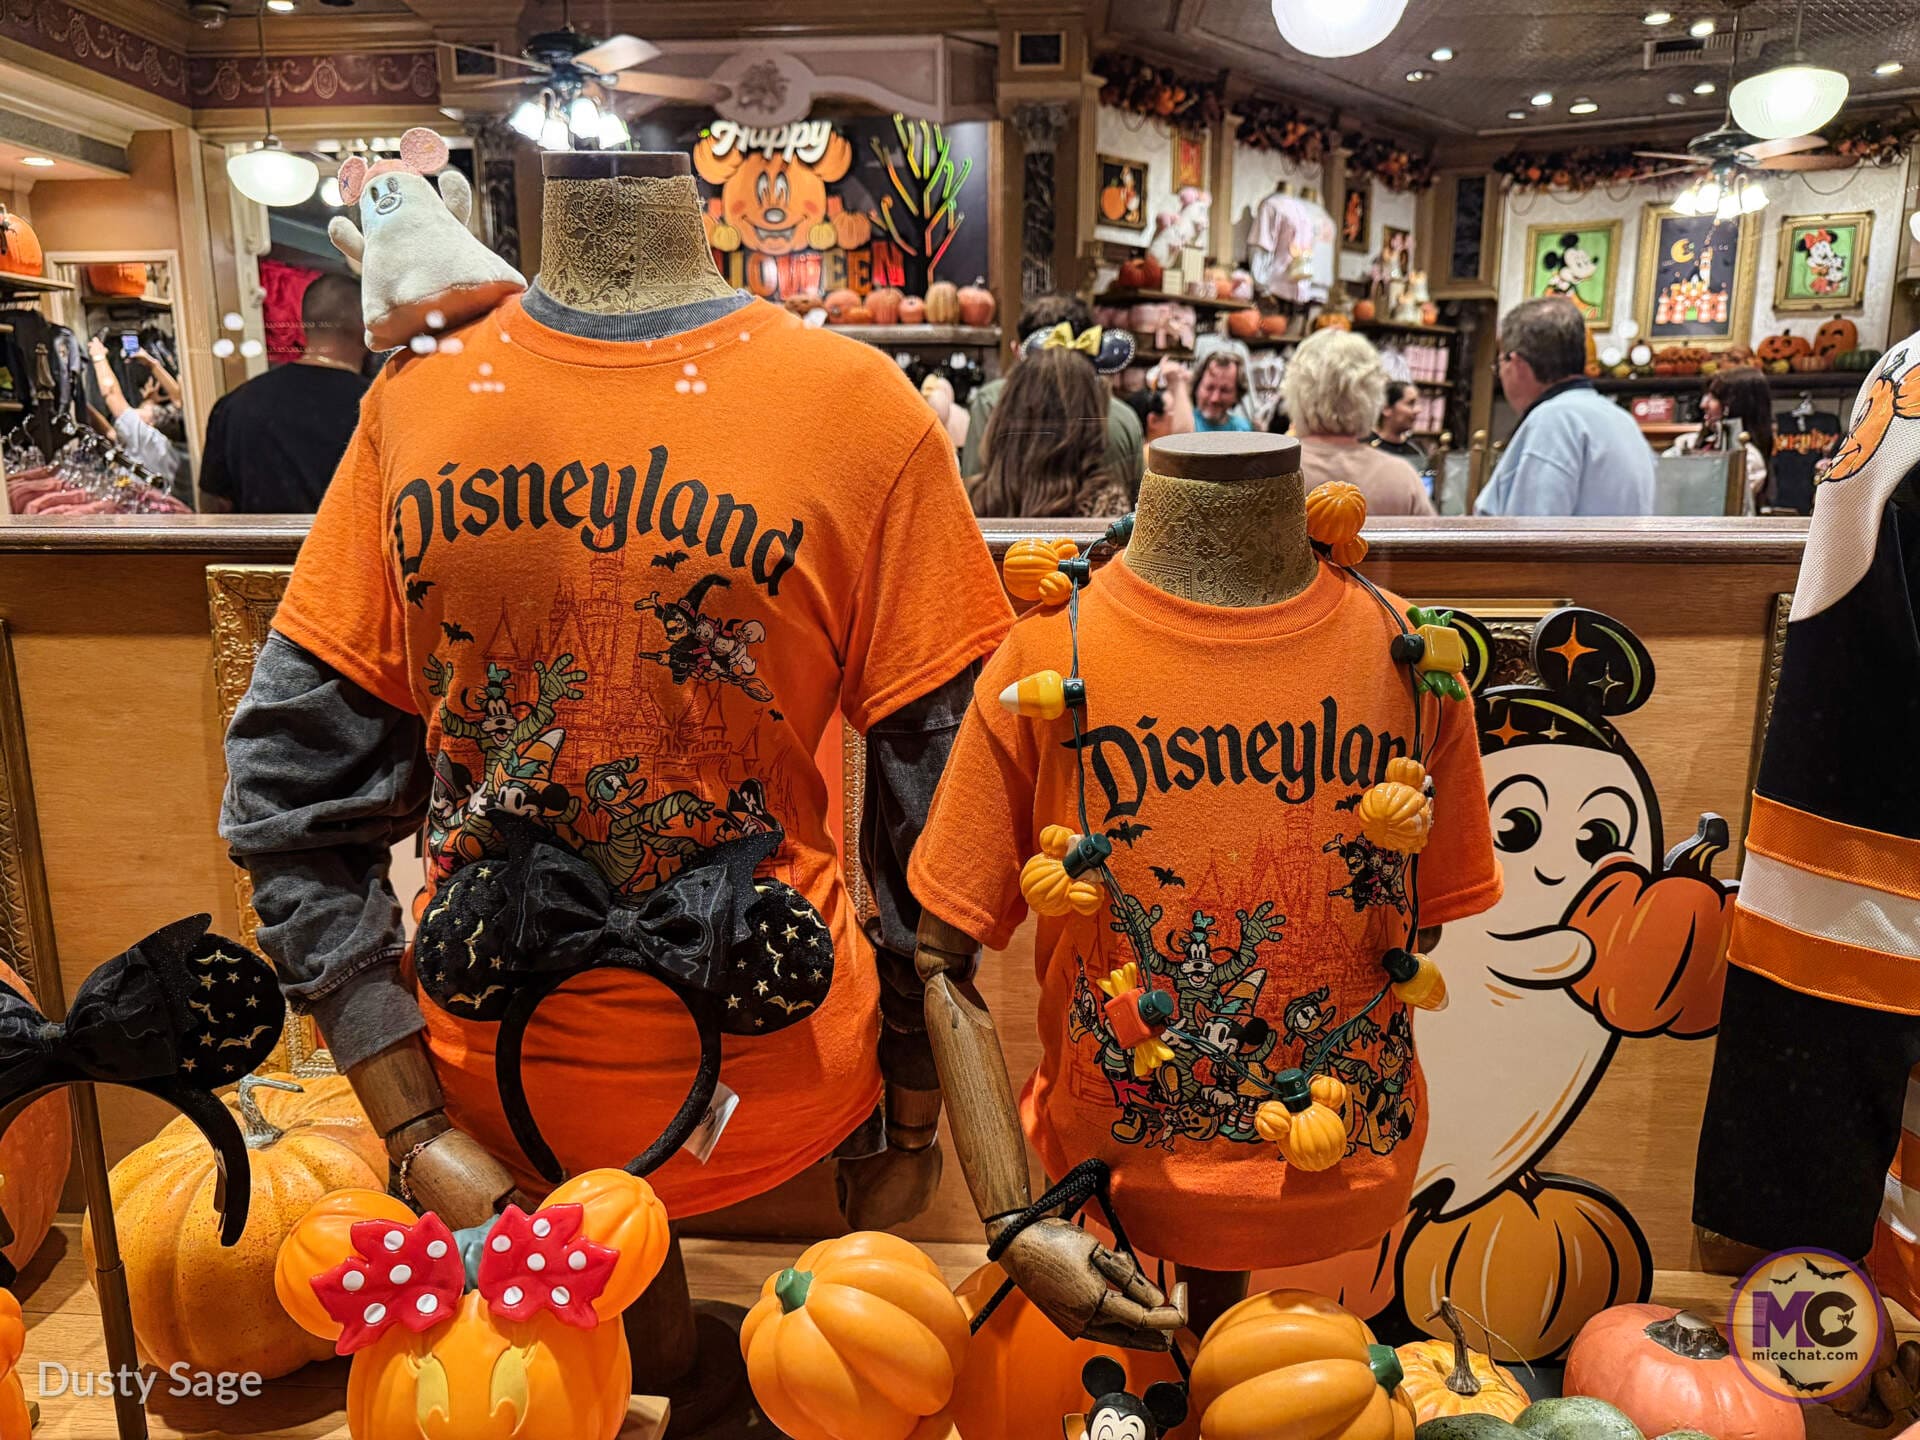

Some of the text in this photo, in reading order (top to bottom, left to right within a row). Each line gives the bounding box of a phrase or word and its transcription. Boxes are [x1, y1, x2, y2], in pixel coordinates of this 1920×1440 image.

[710, 119, 832, 164] Happy
[393, 445, 804, 596] Disneyland
[1060, 695, 1407, 825] Disneylan
